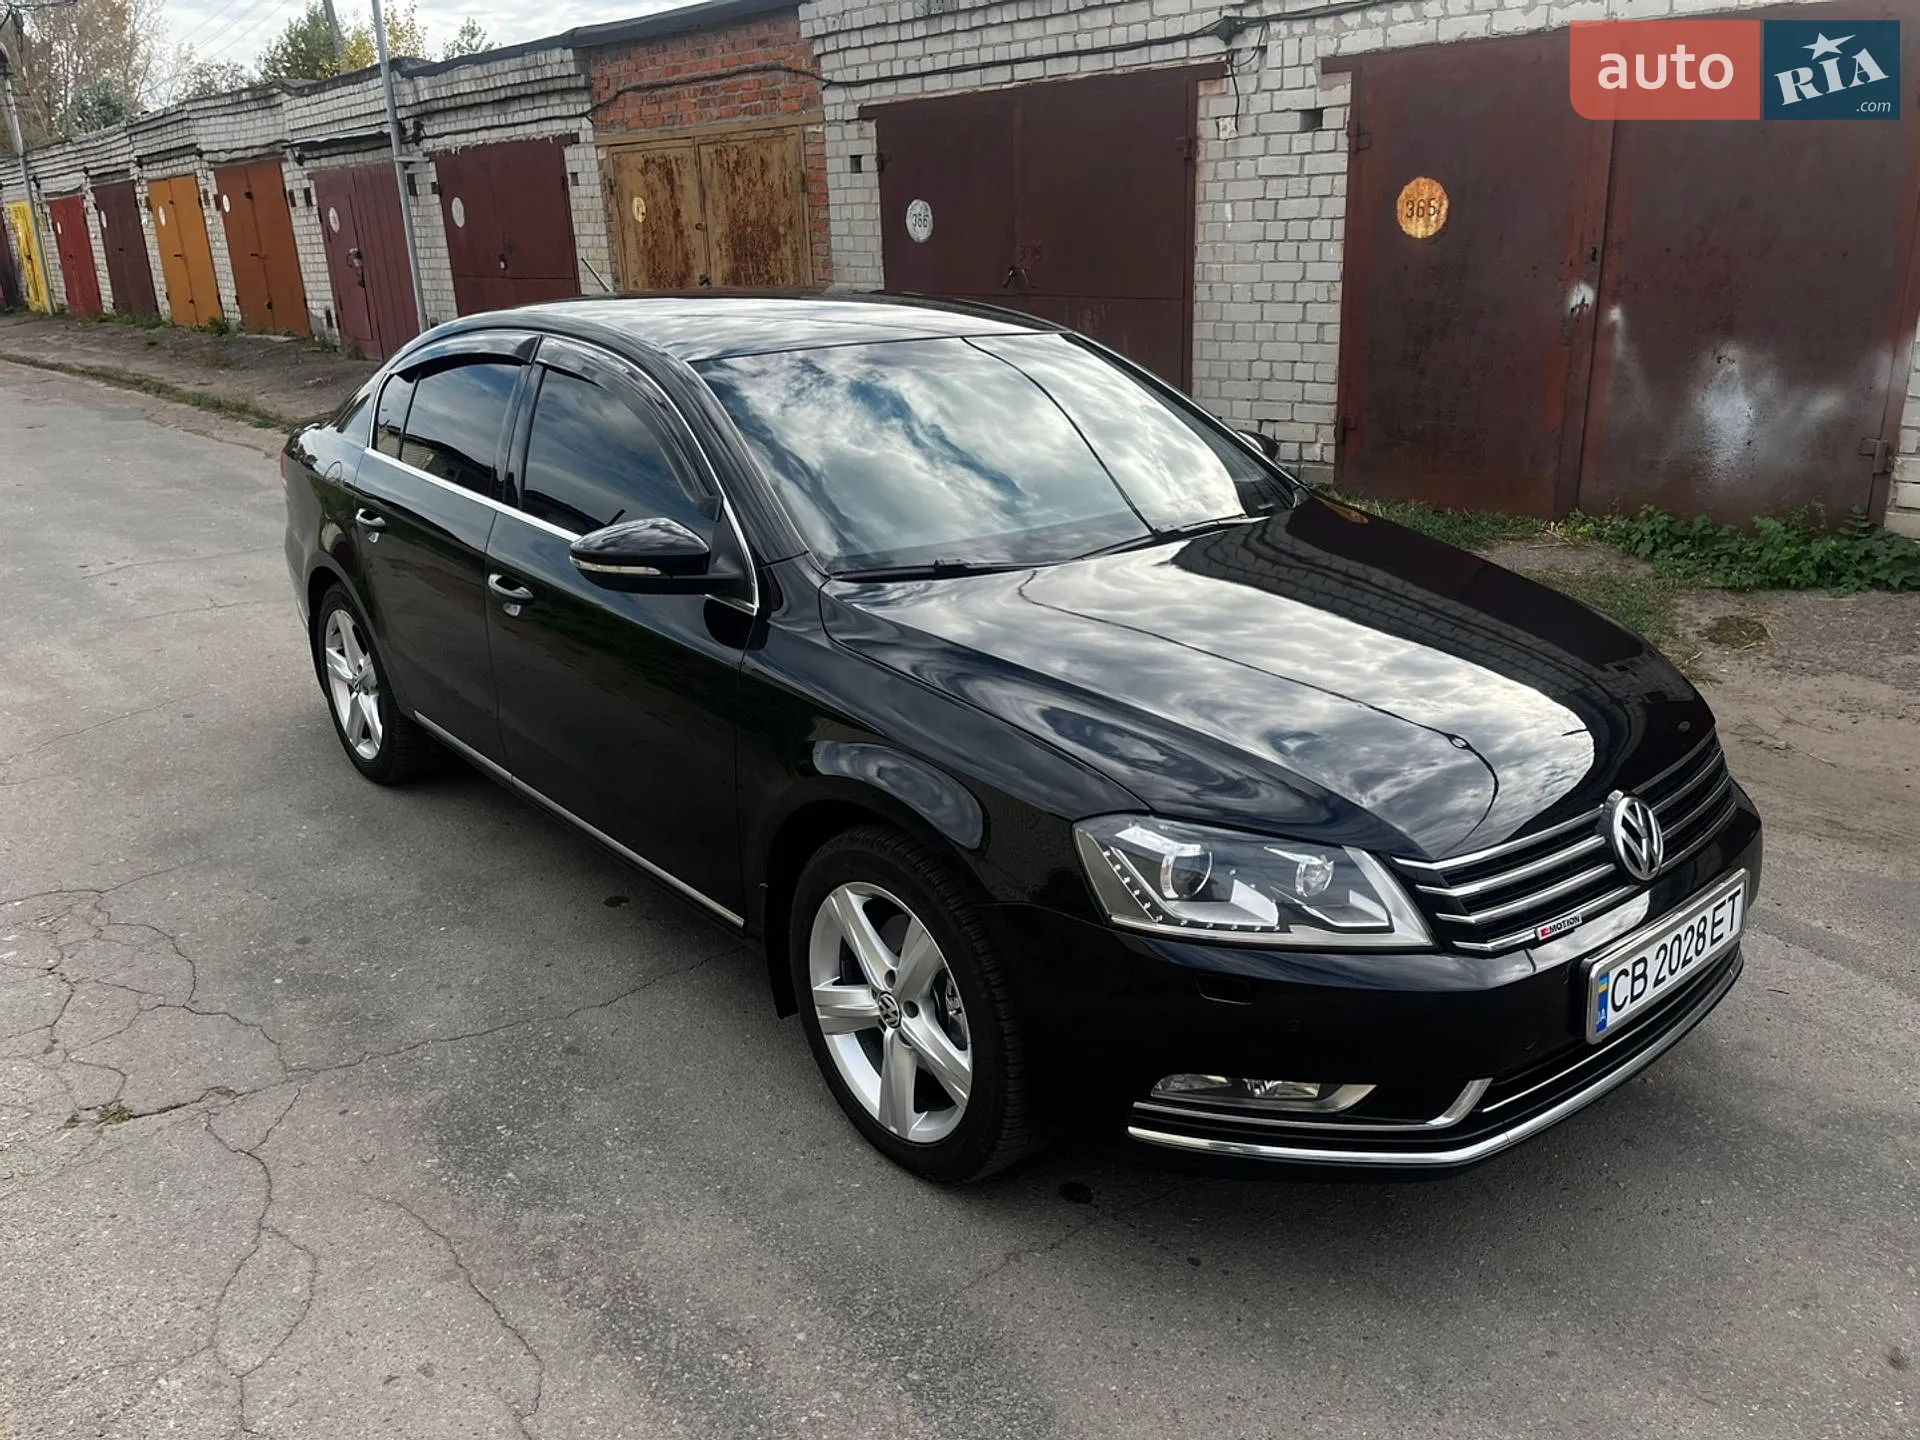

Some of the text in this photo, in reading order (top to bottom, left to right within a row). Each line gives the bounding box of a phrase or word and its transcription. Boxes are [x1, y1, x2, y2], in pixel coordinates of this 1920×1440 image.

[1611, 888, 1741, 1012] CB 2028 ET
